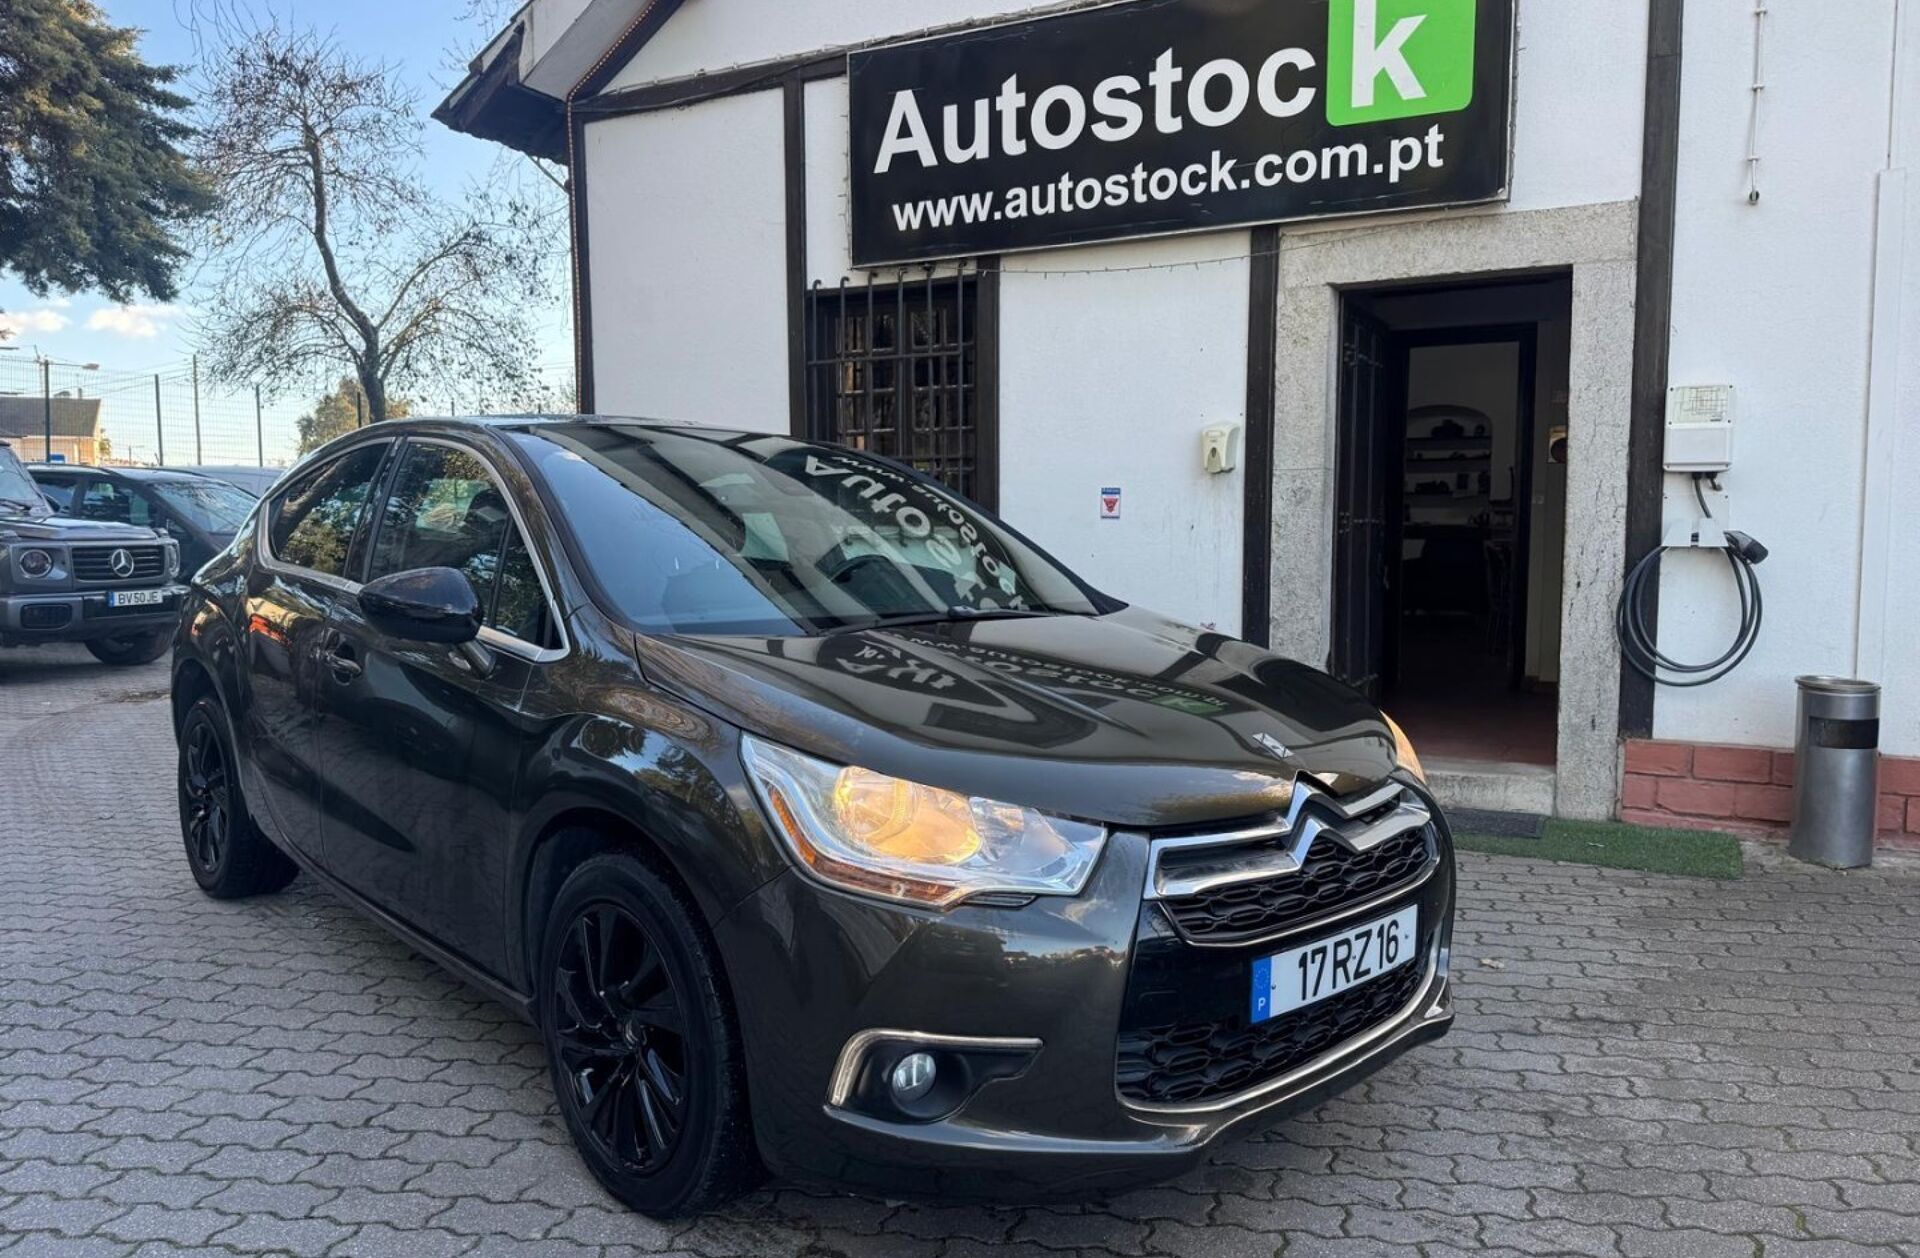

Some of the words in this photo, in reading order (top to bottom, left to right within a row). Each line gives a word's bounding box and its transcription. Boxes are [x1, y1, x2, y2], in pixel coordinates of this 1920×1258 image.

[874, 0, 1427, 174] Autostock
[892, 124, 1444, 231] www.autostock.com.pt
[1257, 997, 1266, 1012] P
